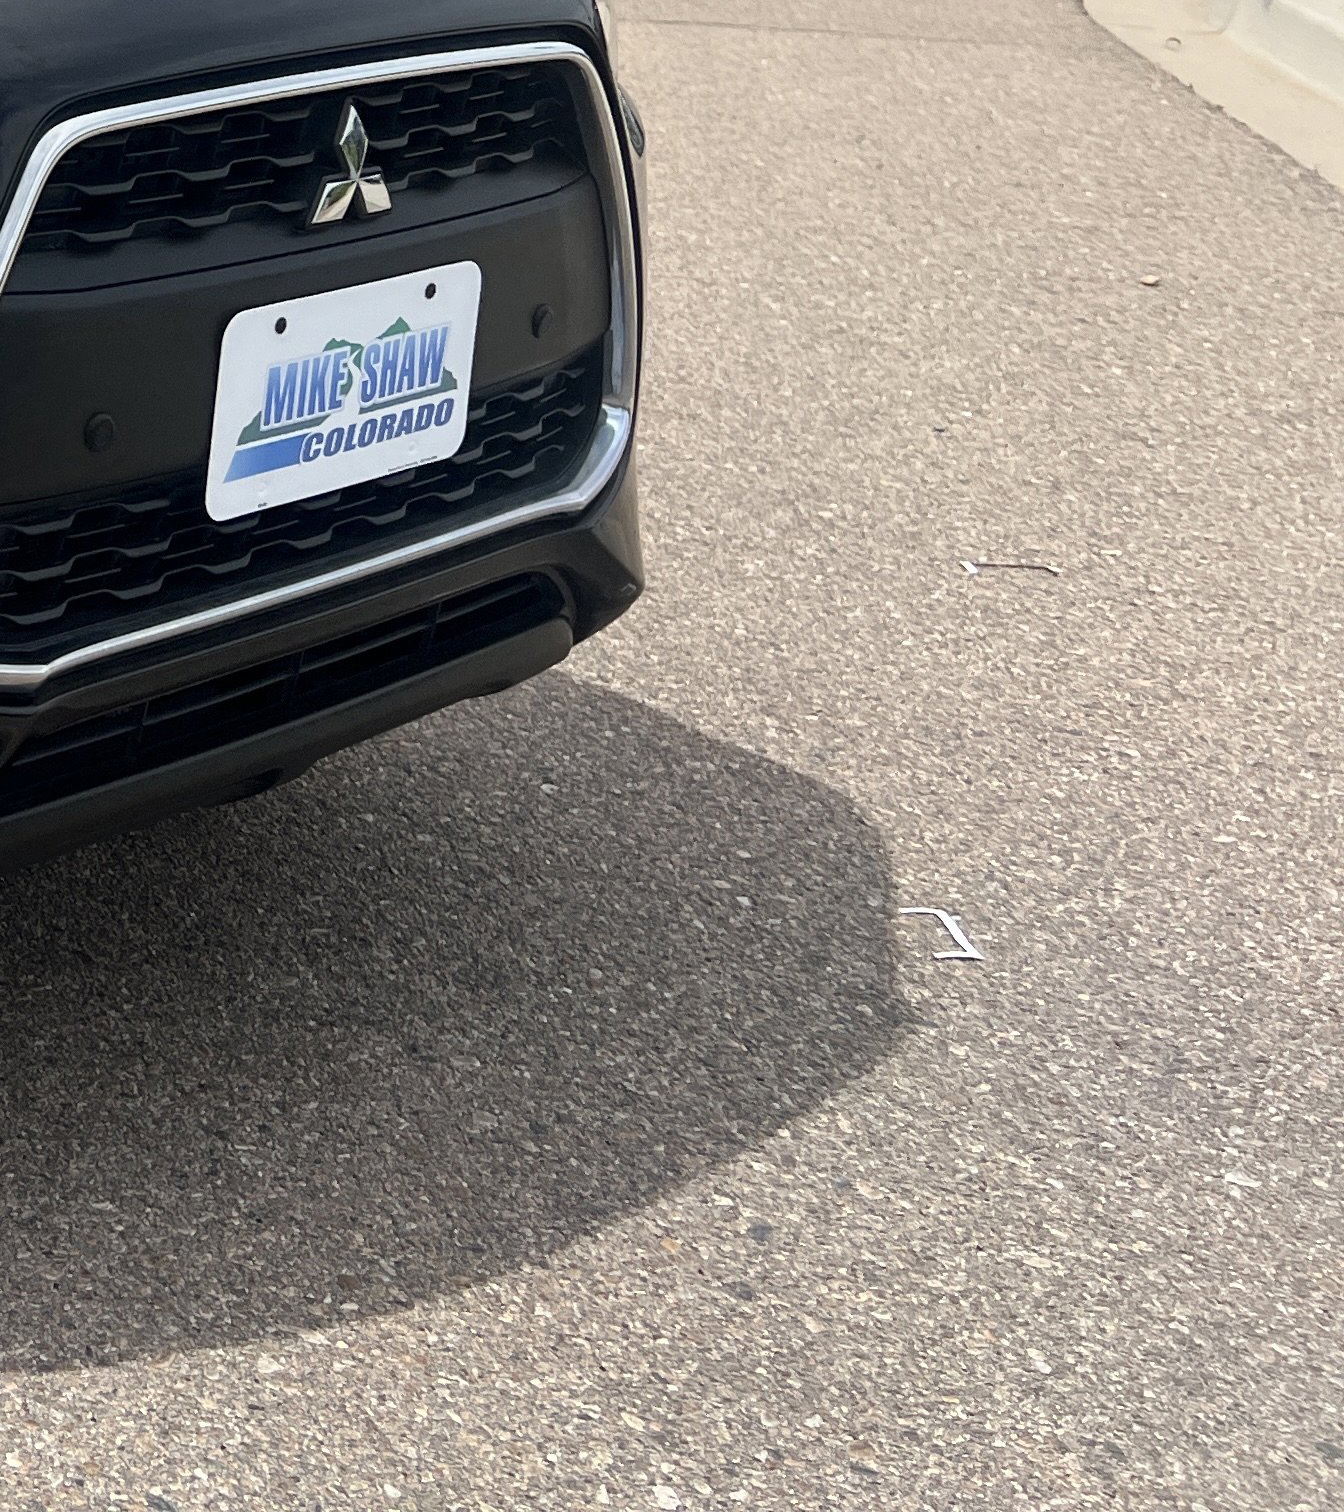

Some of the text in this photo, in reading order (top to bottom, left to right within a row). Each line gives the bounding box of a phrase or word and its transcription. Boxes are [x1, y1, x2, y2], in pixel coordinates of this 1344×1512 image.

[263, 326, 449, 426] MIKE SHAW
[302, 398, 455, 463] COLORADO
